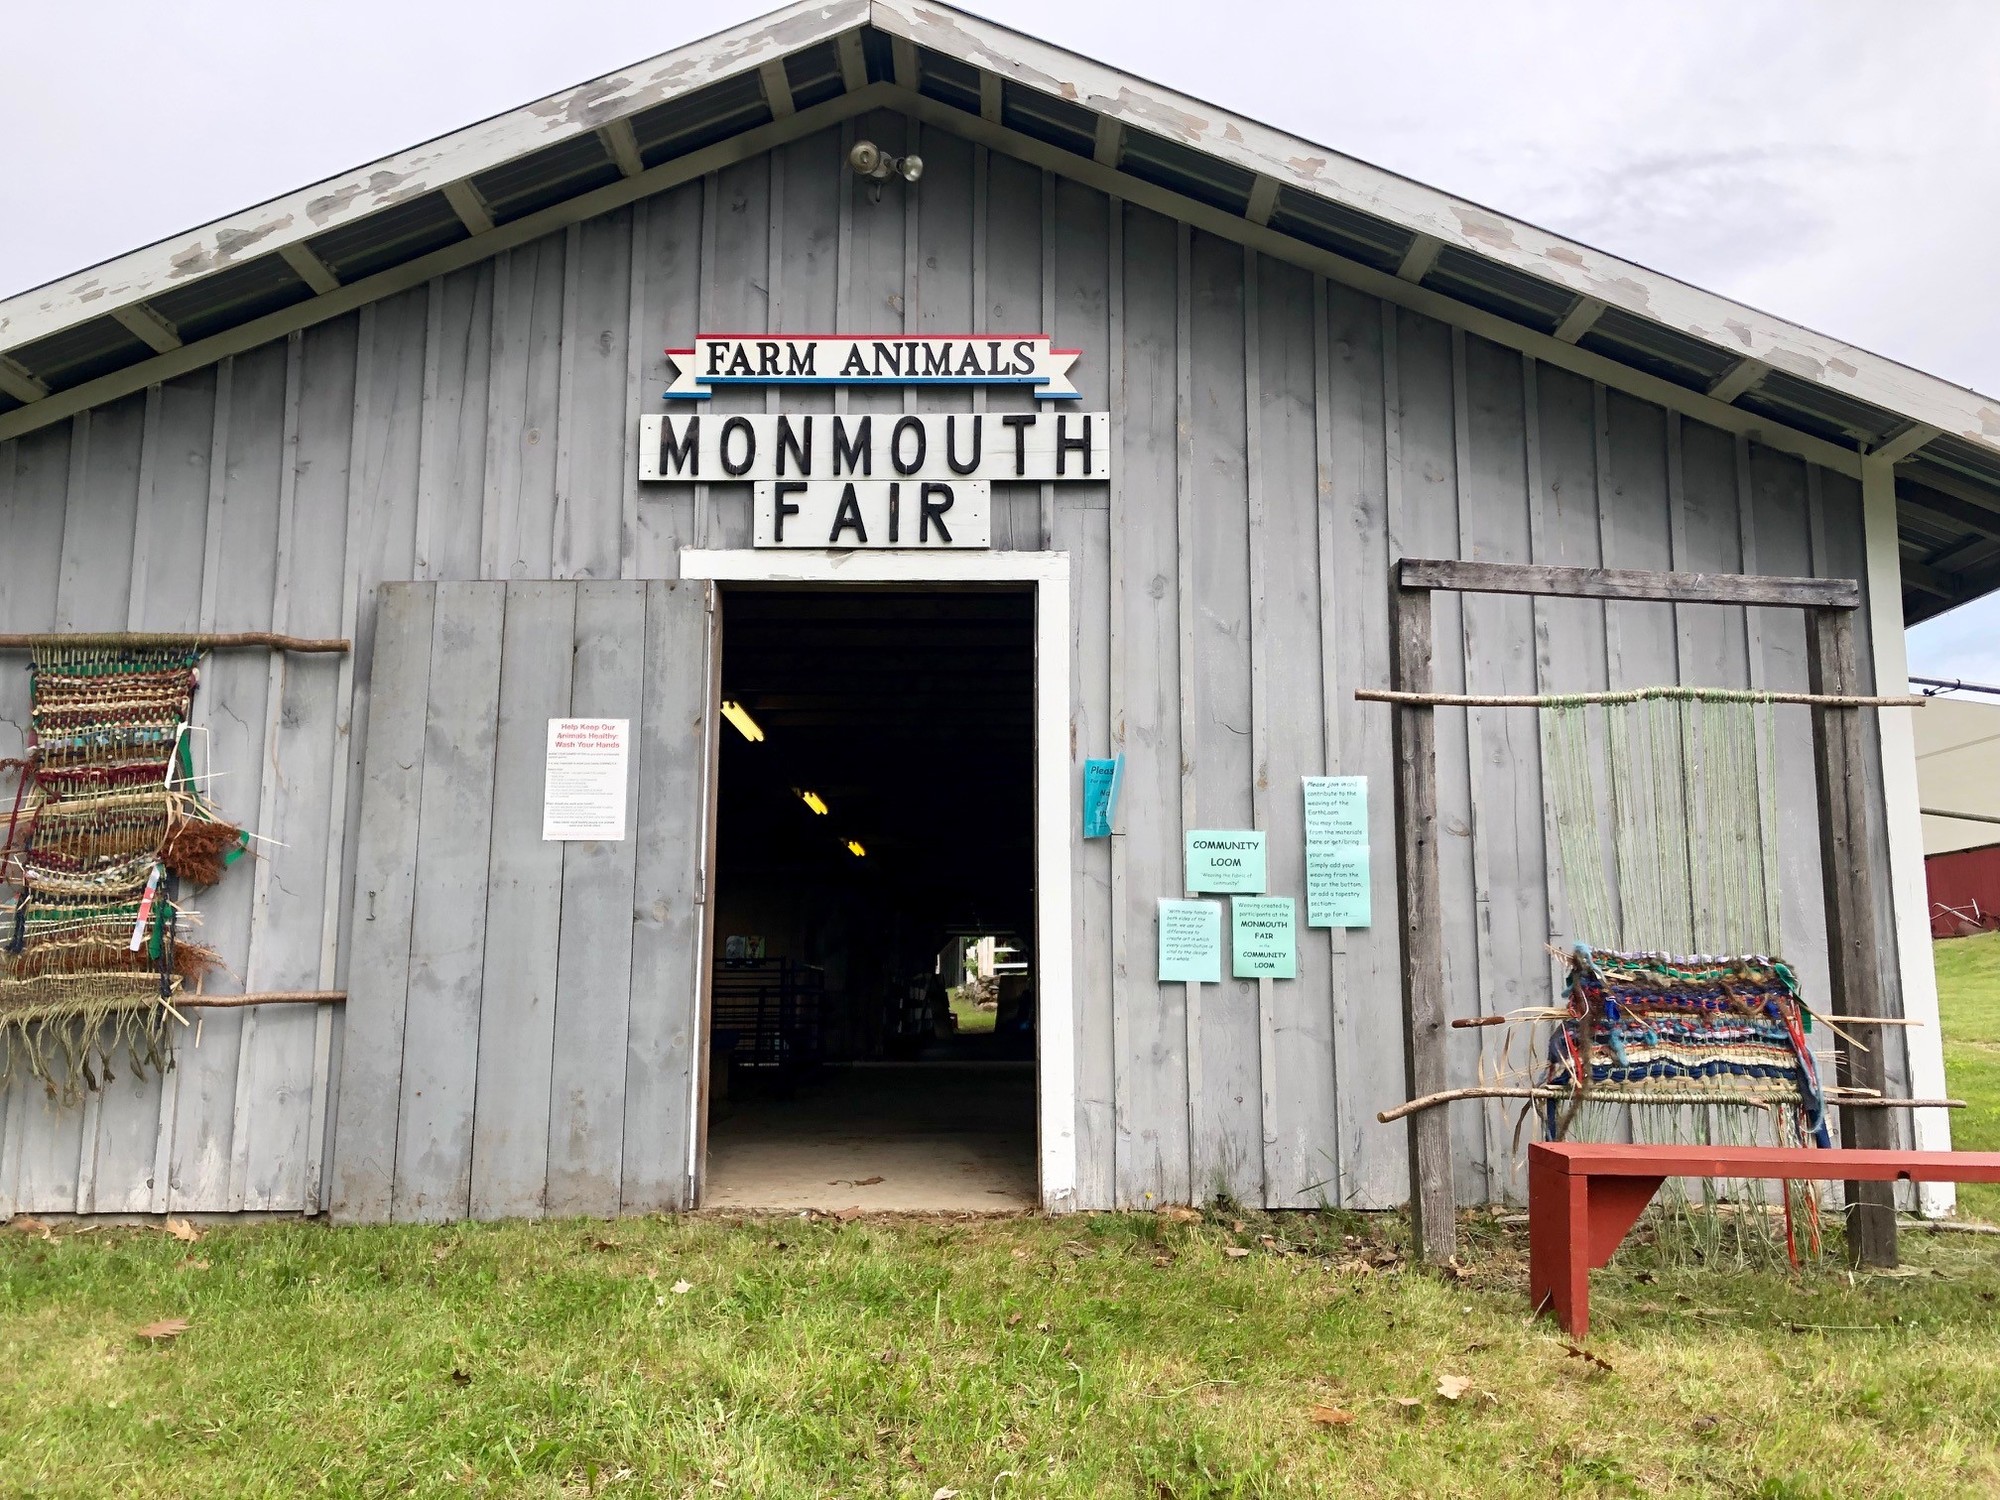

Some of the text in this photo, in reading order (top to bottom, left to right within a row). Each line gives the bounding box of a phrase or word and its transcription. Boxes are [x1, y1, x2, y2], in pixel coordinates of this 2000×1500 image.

[705, 341, 1036, 377] FARM ANIMALS
[659, 415, 1092, 475] MONMOUTH
[774, 482, 954, 542] FAIR
[1193, 841, 1259, 850] COMMUNITY
[1211, 858, 1241, 866] LOOM
